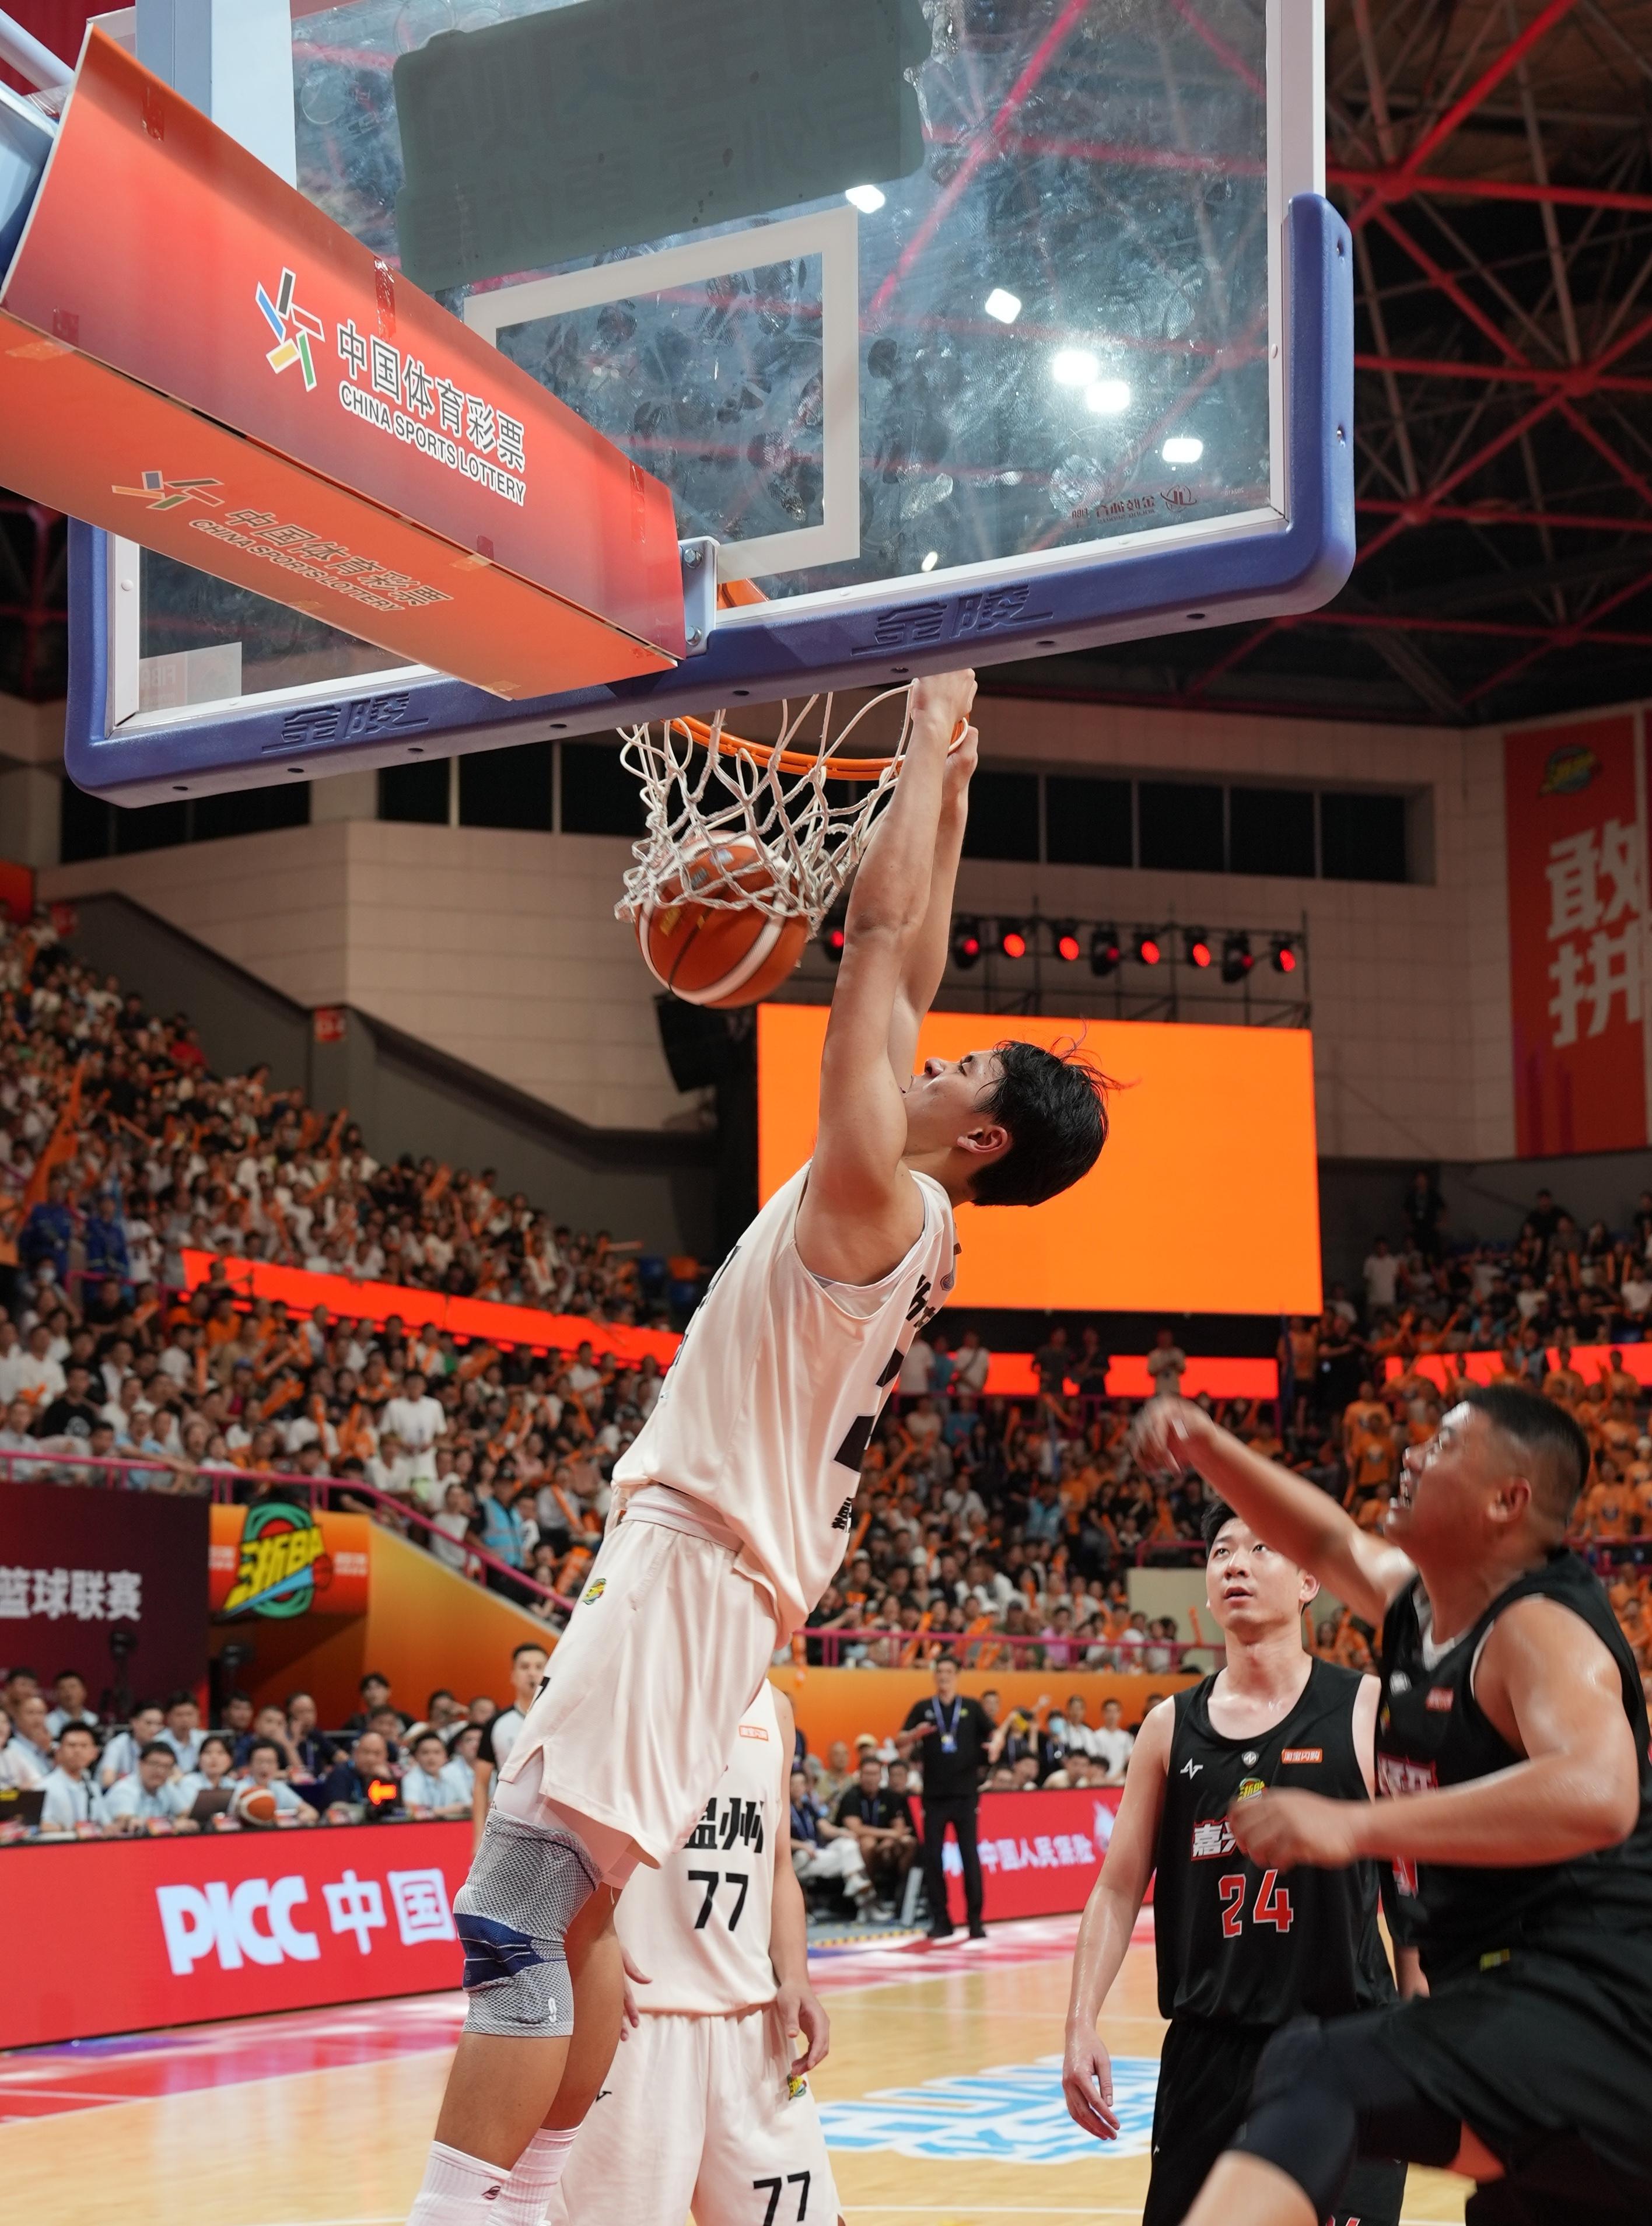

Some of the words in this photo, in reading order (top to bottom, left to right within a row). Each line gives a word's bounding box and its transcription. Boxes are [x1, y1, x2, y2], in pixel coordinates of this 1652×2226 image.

[337, 318, 525, 473] 中国体育彩票
[340, 380, 393, 433] CHINA
[393, 411, 458, 469] SPORTS
[459, 447, 526, 506] LOTTERY
[189, 519, 257, 548] CHINA
[247, 545, 331, 581] SPORTS
[314, 575, 405, 611] LOTTERY
[225, 509, 454, 606] 中国体育彩票
[1545, 818, 1645, 1048] 敢拼
[156, 1875, 320, 1976] PICC
[321, 1868, 457, 1955] 中国
[688, 1870, 749, 1932] 77
[1218, 1868, 1294, 1938] 24
[752, 2171, 811, 2226] 77
